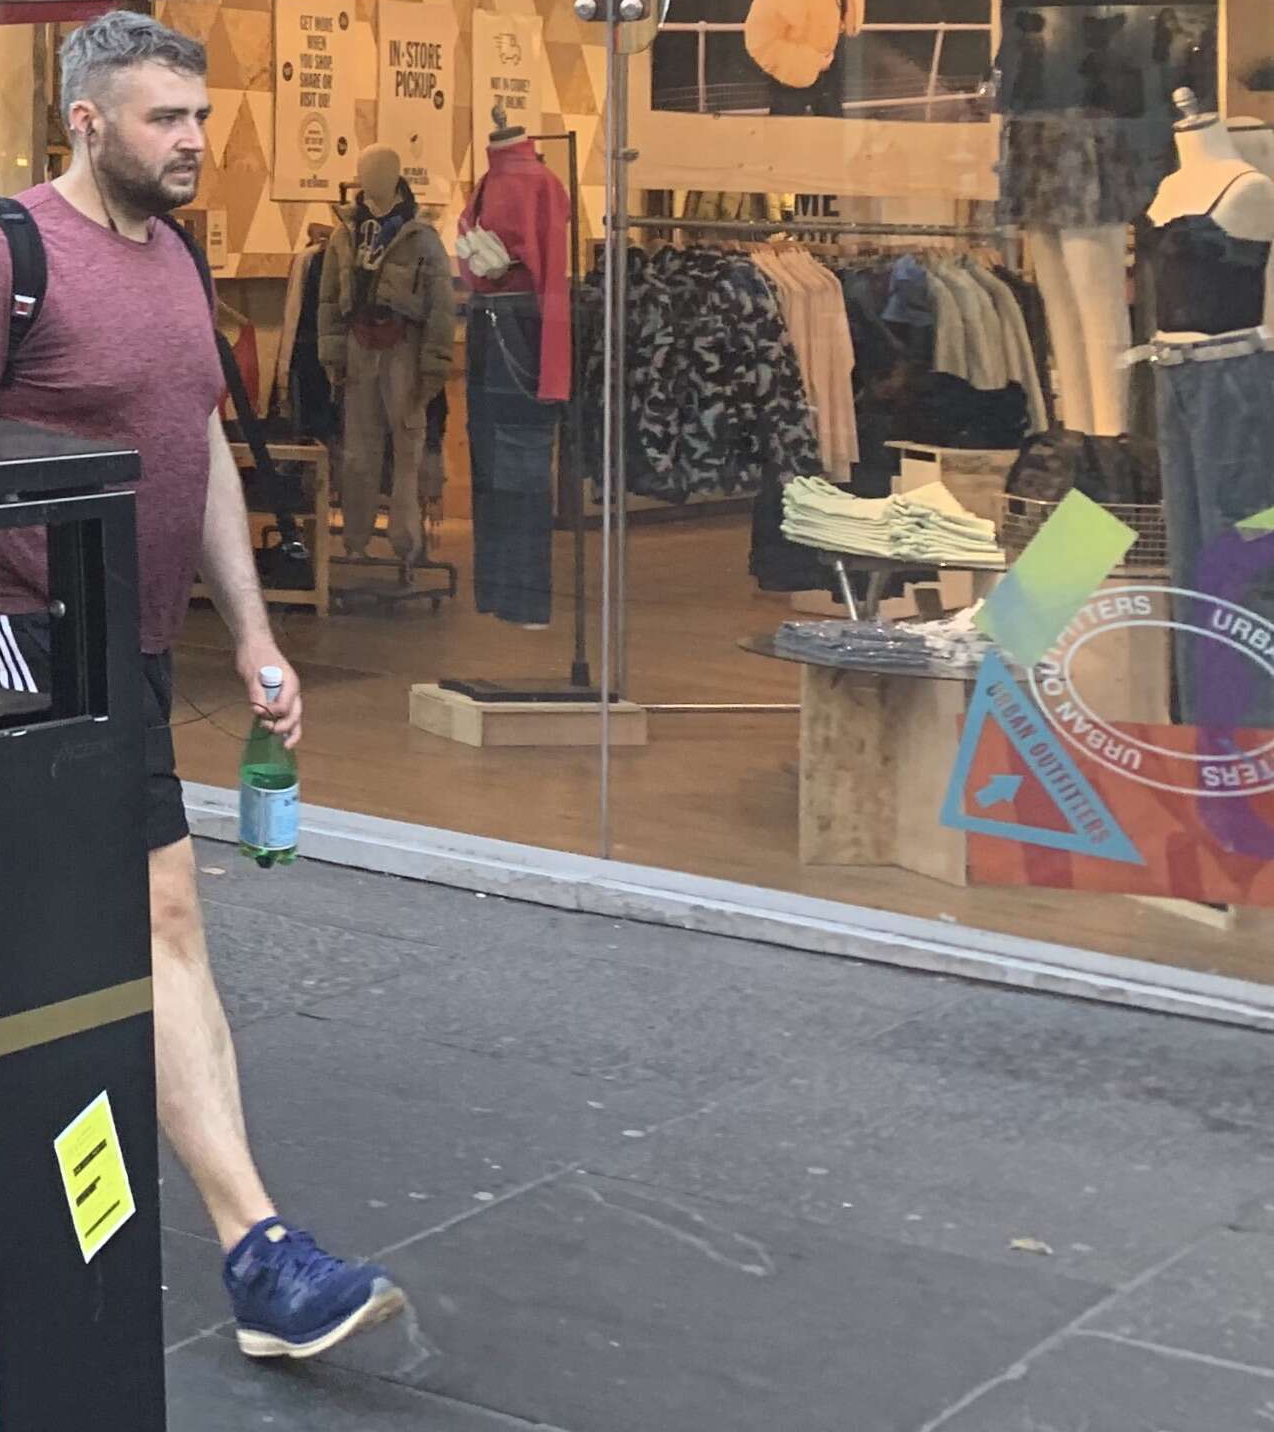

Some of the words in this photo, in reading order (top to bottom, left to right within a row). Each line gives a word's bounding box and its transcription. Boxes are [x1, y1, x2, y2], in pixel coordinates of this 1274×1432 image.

[395, 70, 436, 99] PICKUP
[986, 682, 1038, 740] URBAN
[1055, 701, 1143, 770] URBAN
